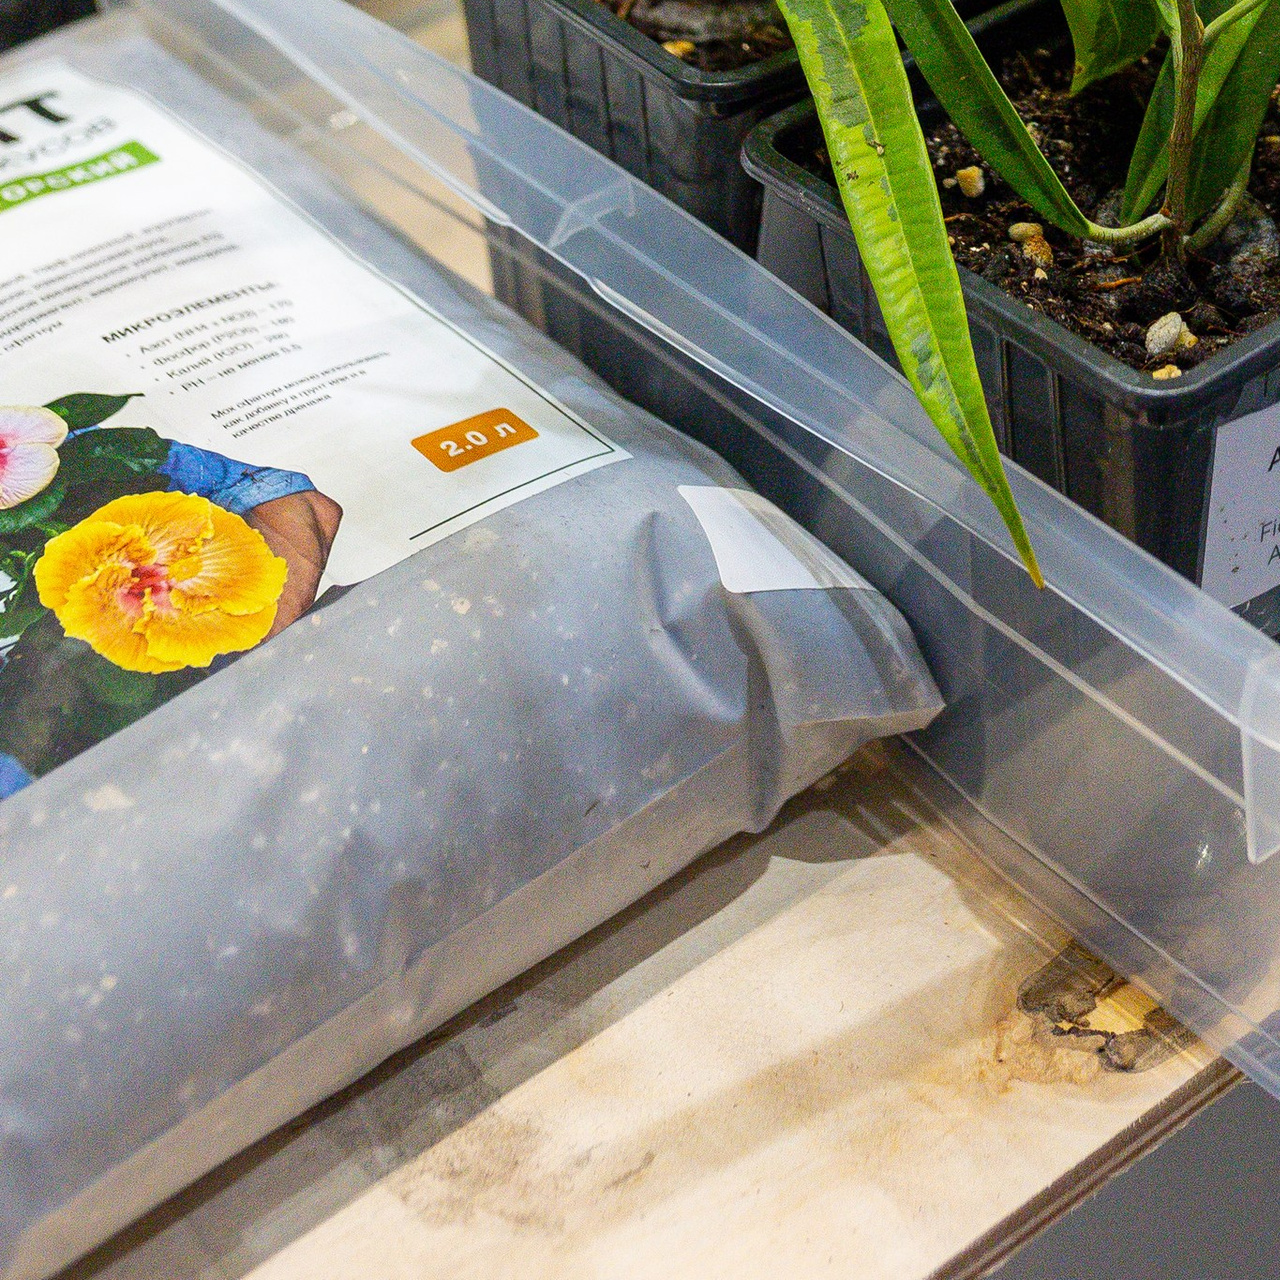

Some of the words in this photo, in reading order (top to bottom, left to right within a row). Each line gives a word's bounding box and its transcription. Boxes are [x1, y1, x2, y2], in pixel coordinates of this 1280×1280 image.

[153, 341, 211, 367] Фосфор
[166, 357, 213, 380] Калий
[211, 404, 236, 421] Мох
[237, 386, 283, 409] сфагнум
[222, 416, 244, 430] как
[244, 398, 290, 421] добавку
[283, 393, 333, 418] дренажа
[440, 430, 489, 458] 2.0
[493, 422, 518, 438] л
